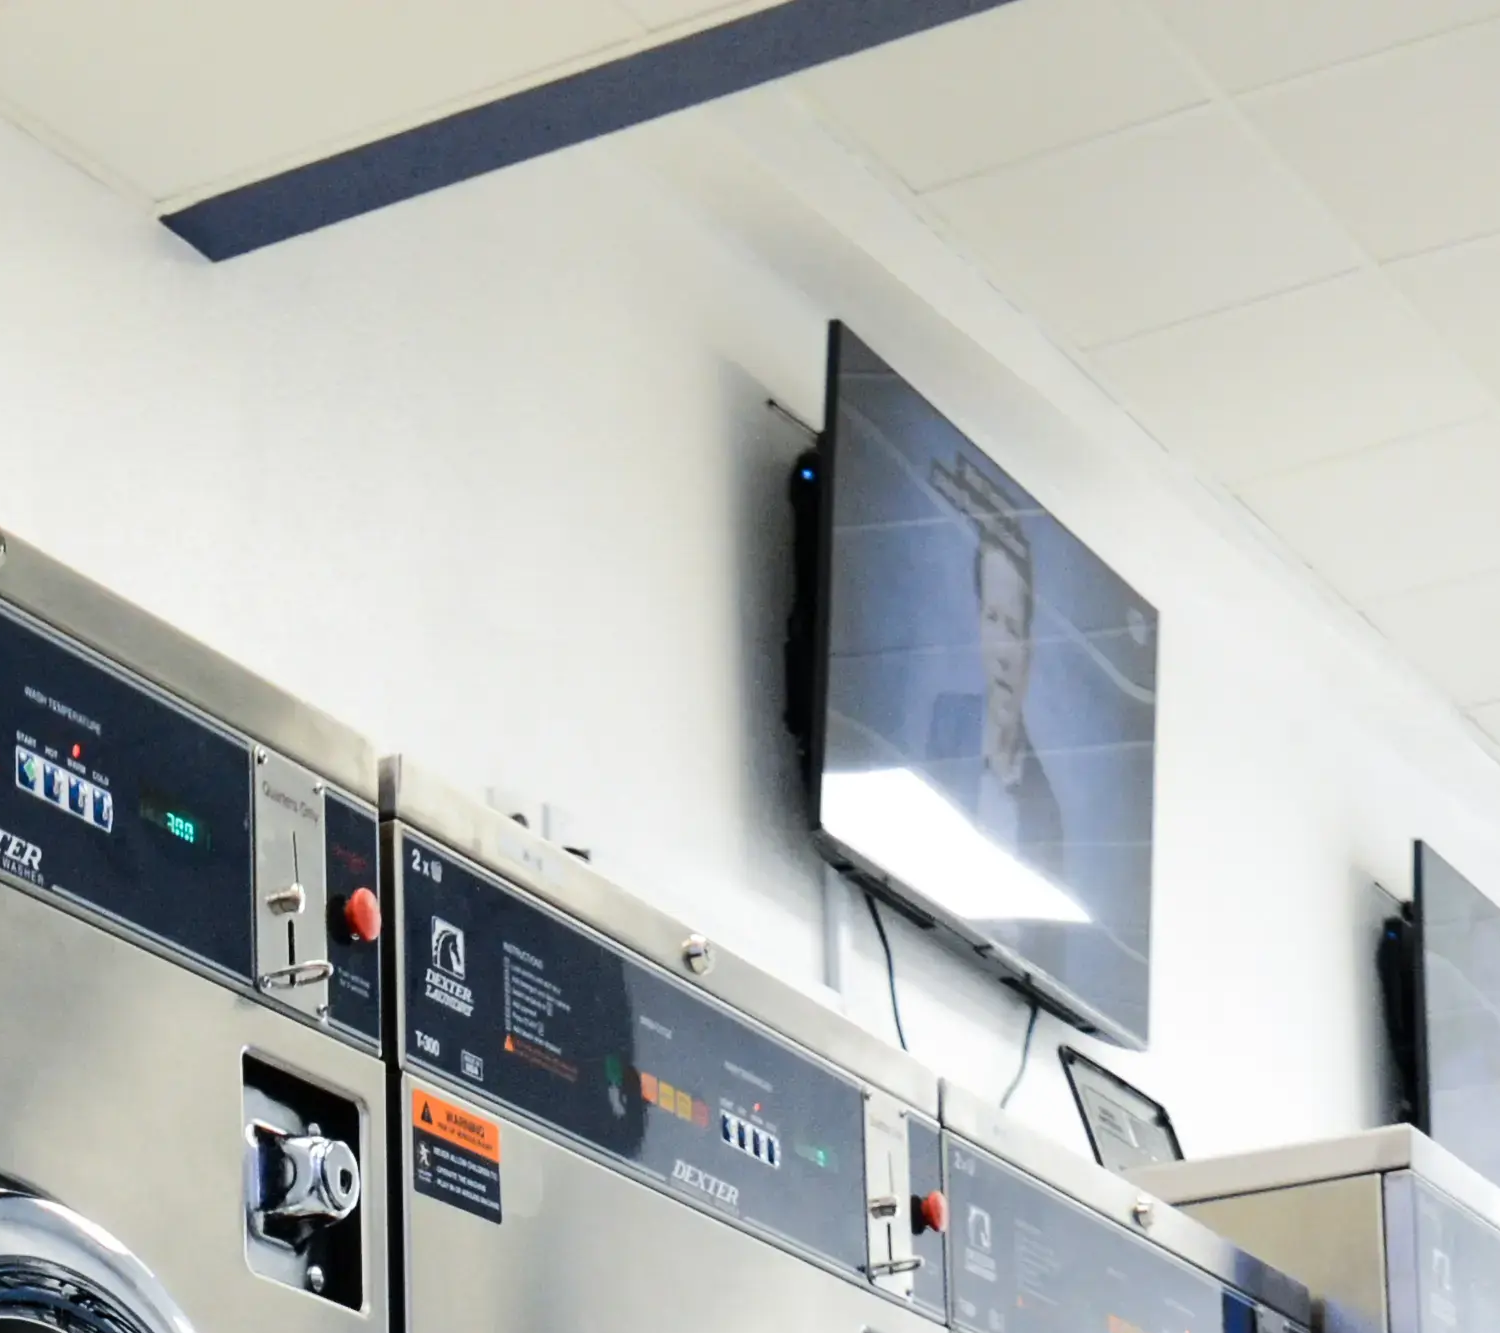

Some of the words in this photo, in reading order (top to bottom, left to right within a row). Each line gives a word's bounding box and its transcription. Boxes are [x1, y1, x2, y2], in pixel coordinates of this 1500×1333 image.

[24, 685, 47, 705] WASH
[48, 697, 101, 736] TEMPERATURE
[2, 856, 44, 886] WASHER
[411, 848, 421, 871] 2
[425, 967, 472, 999] DEXTER
[672, 1159, 740, 1206] DEXTER
